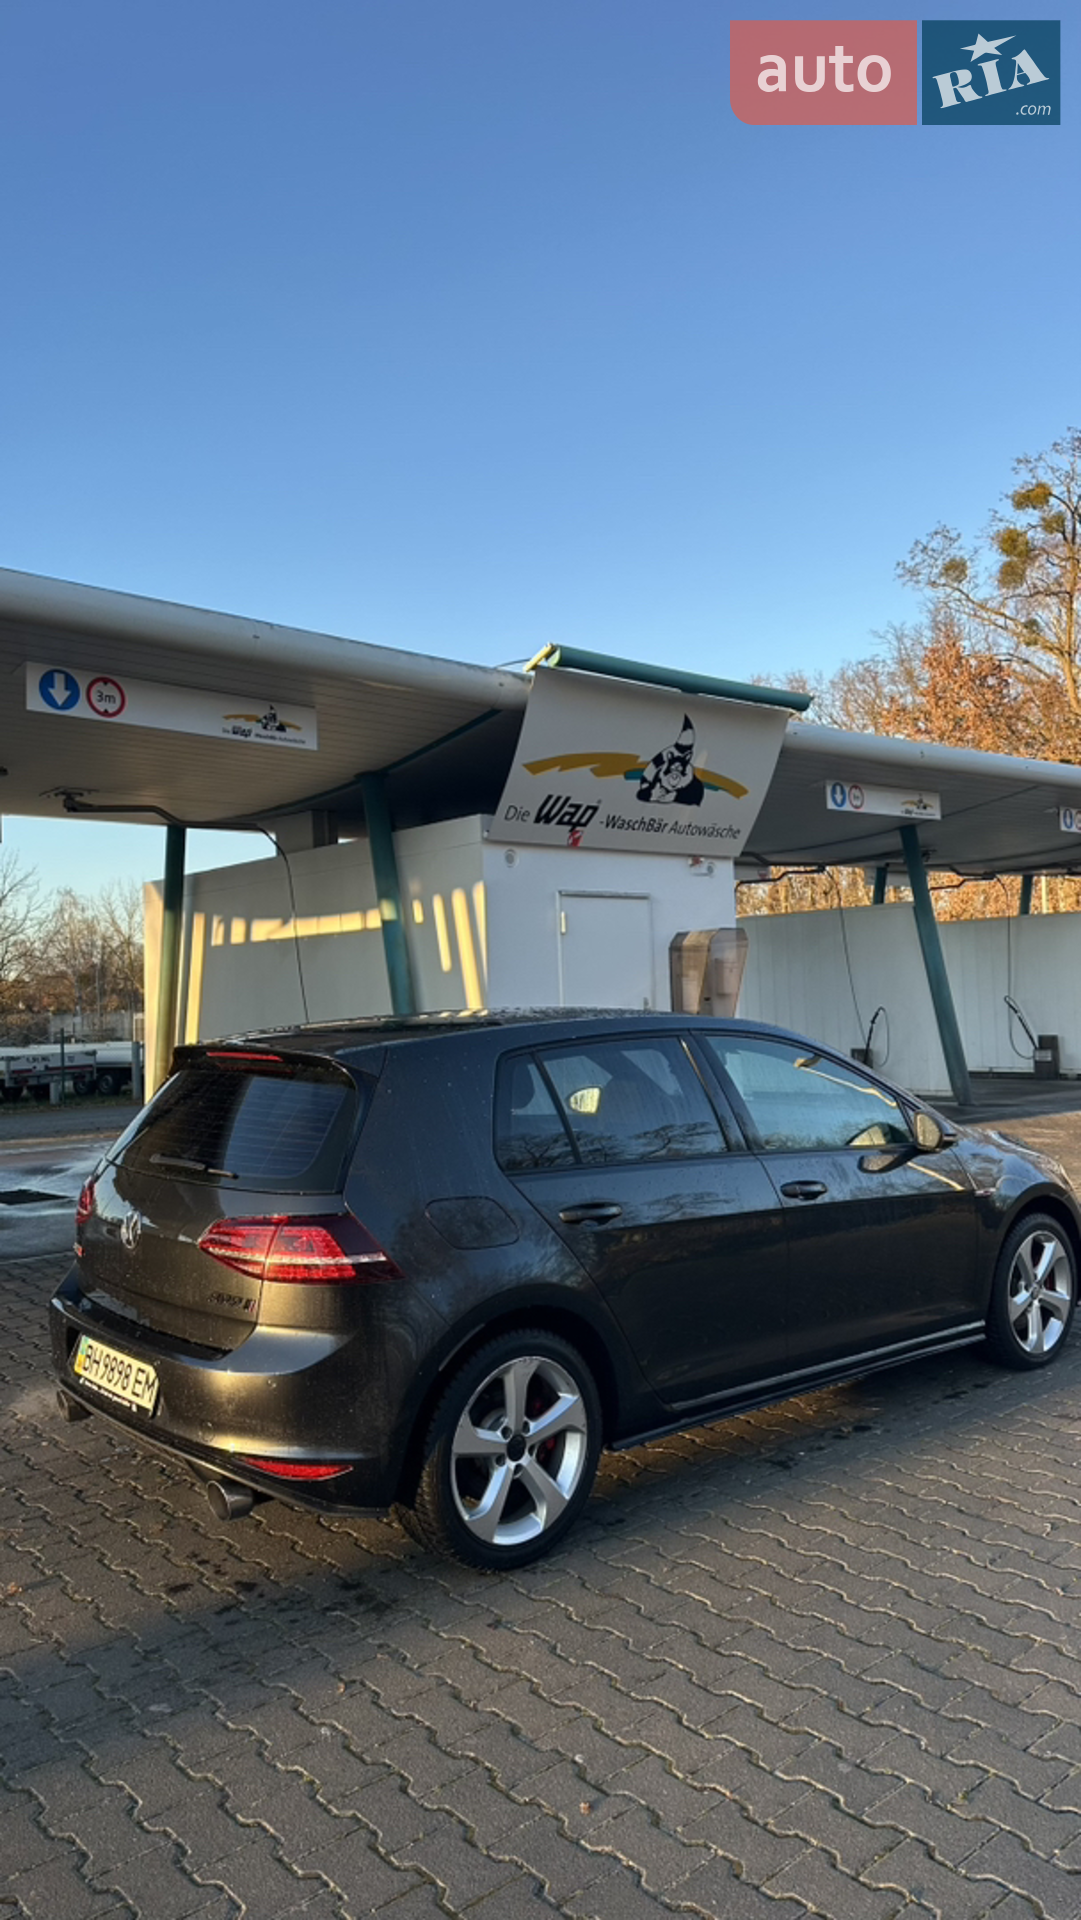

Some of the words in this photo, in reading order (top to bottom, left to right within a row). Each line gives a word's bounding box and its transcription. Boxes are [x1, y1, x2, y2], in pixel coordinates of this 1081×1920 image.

[504, 805, 531, 822] Die
[668, 820, 741, 840] Autowäsche
[100, 1354, 133, 1391] 9898
